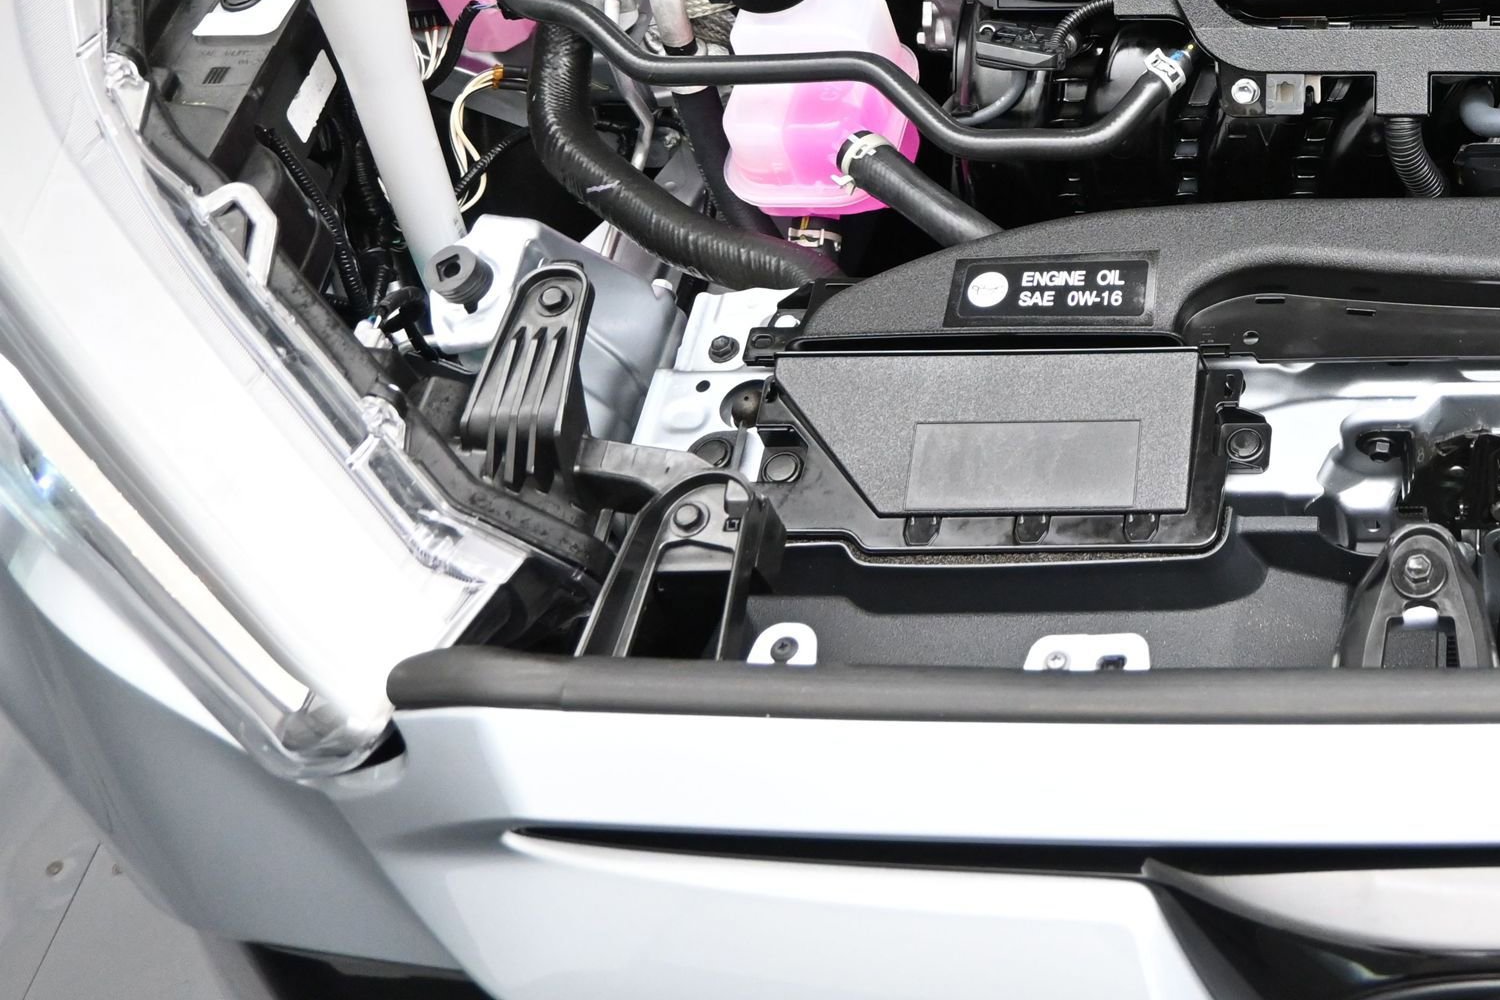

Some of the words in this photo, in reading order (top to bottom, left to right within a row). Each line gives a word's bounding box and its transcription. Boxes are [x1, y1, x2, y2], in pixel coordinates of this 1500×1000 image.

[1021, 270, 1086, 287] ENGINE
[1096, 269, 1125, 286] OIL
[1018, 290, 1056, 307] SAE
[1066, 290, 1123, 306] 0W-16
